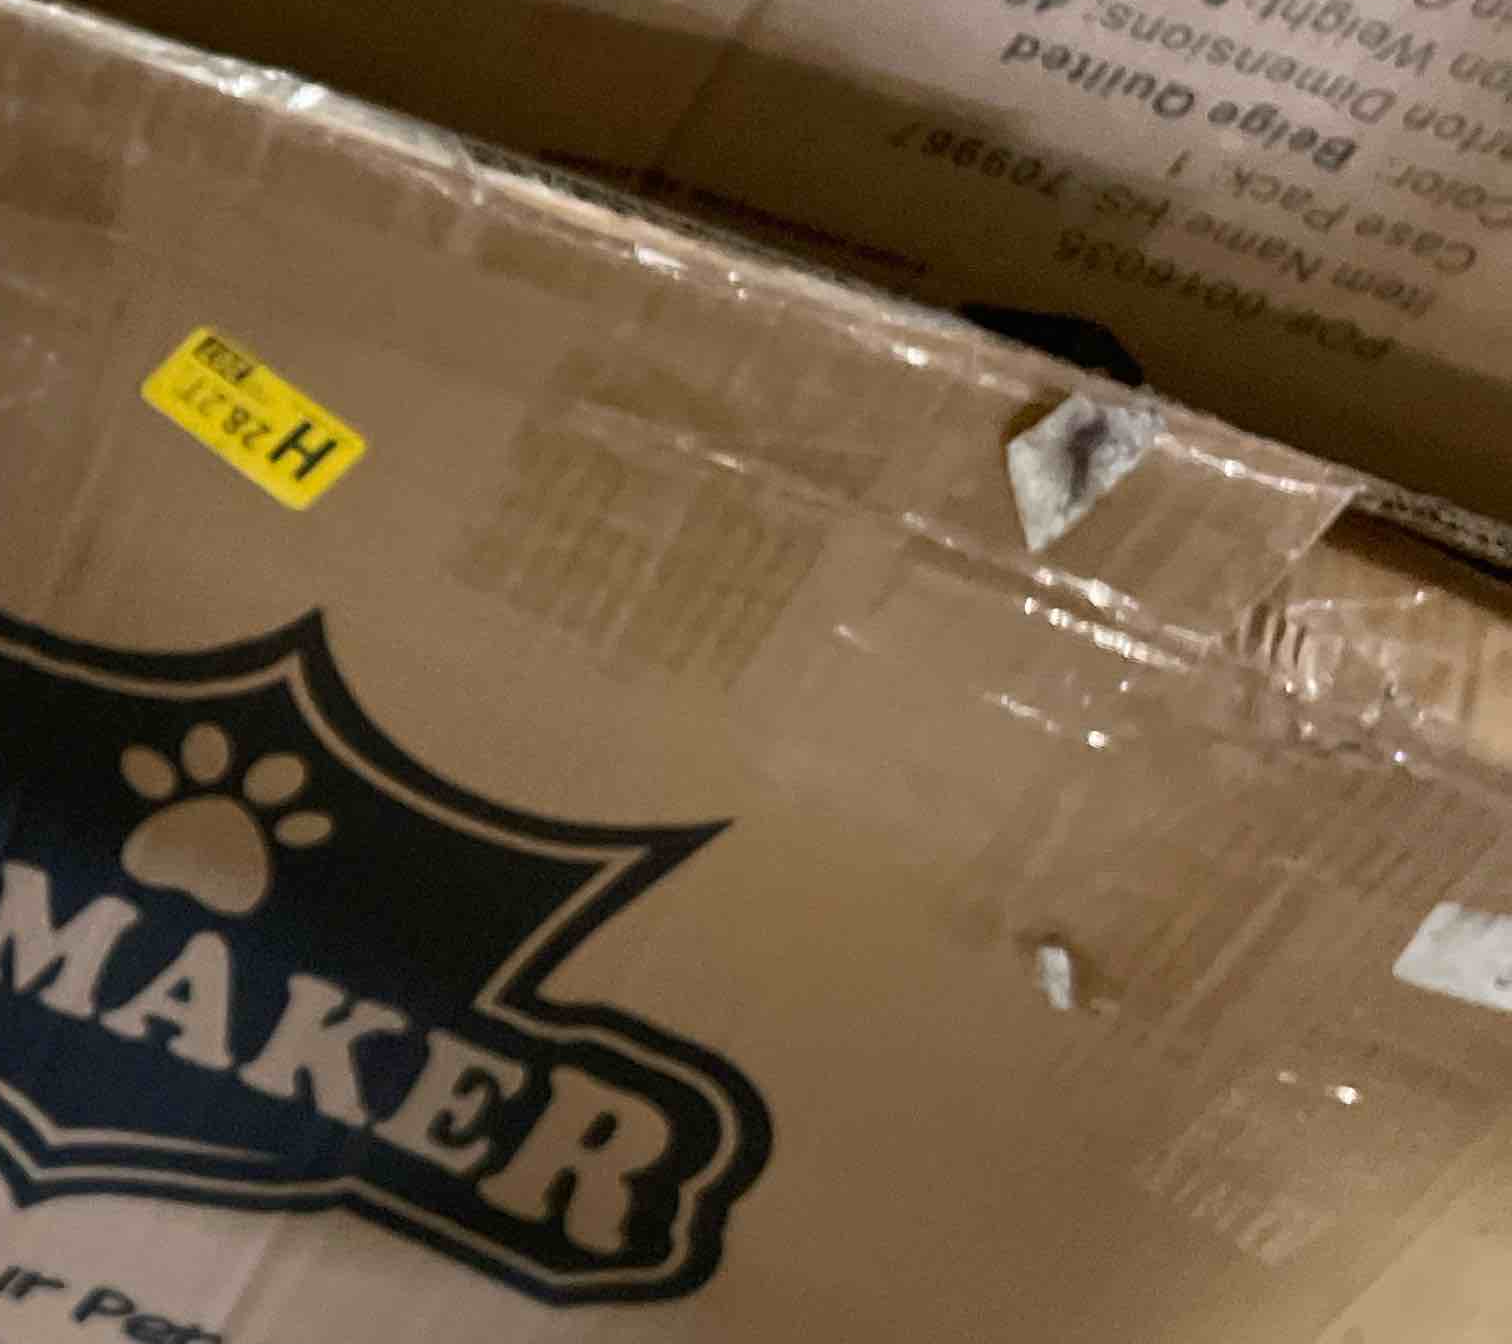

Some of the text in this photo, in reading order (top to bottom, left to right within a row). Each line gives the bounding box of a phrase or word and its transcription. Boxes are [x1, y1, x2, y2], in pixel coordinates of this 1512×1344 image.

[1000, 33, 1195, 119] Quilted
[1171, 150, 1189, 178] 1
[1208, 100, 1358, 173] Beige
[1355, 212, 1477, 275] Case
